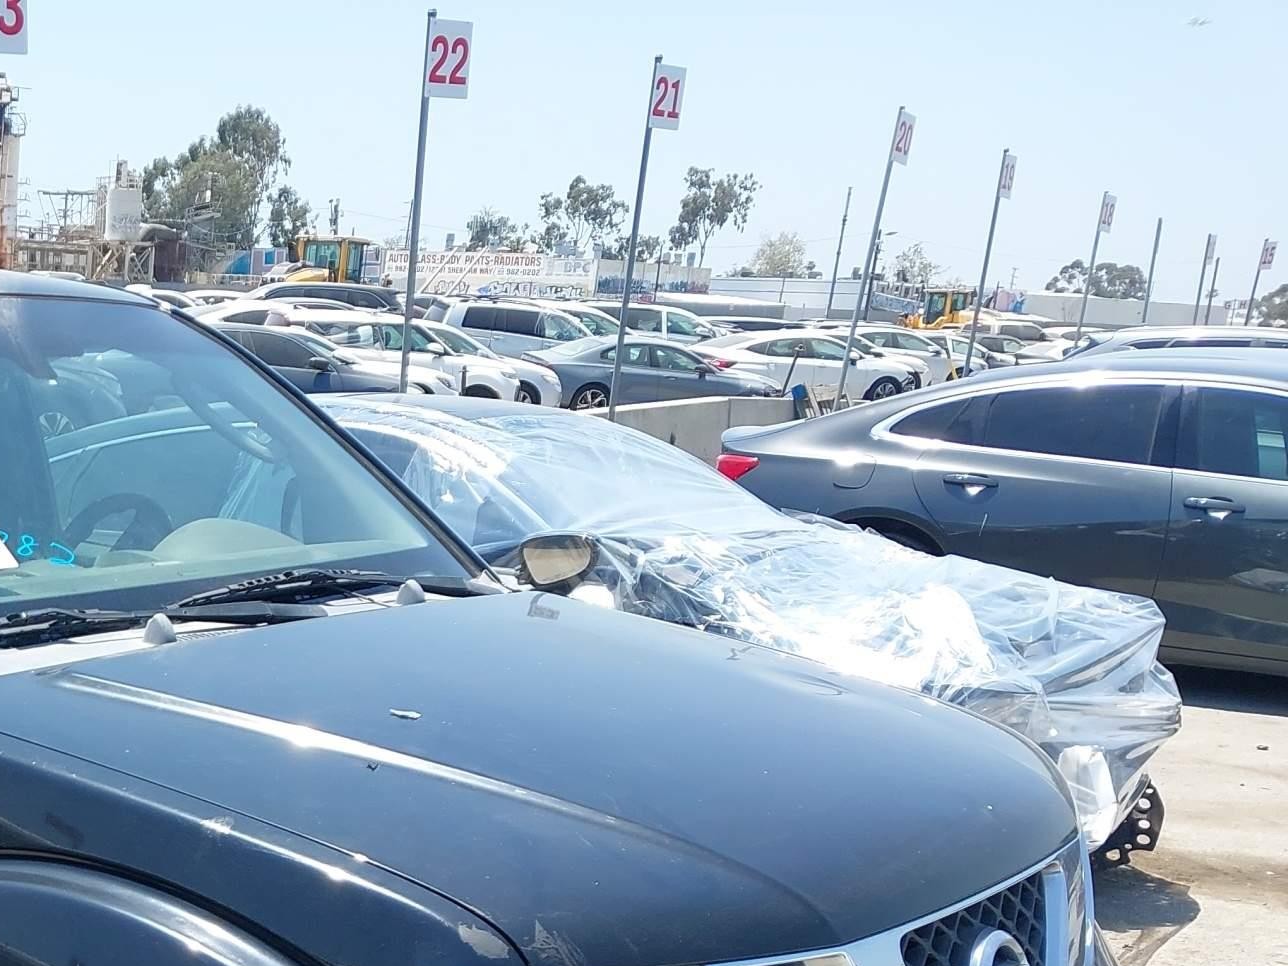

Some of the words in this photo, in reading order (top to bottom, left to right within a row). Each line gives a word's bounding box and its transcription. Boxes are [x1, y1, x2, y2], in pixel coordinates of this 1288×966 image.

[428, 34, 469, 85] 22
[652, 76, 681, 119] 21
[895, 121, 913, 155] 20
[388, 253, 410, 263] AUTO
